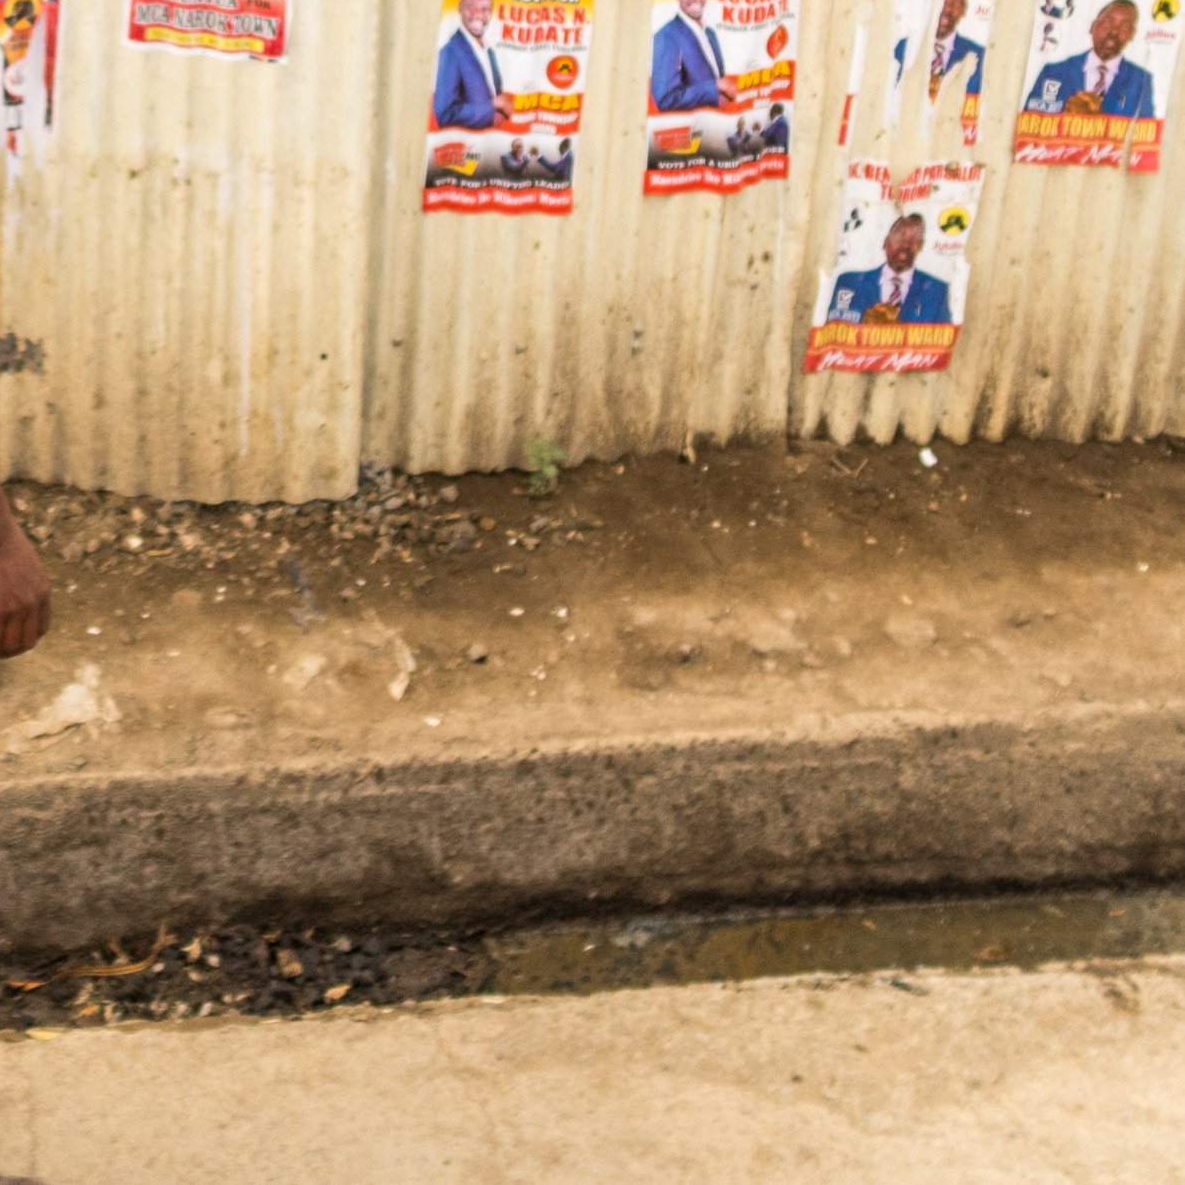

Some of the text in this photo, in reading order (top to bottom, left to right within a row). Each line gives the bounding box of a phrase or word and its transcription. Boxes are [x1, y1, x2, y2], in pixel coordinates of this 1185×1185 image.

[497, 3, 566, 26] LUCAS
[501, 23, 582, 46] KUDATE
[513, 94, 580, 113] MCA
[658, 158, 686, 170] VOTE
[434, 177, 532, 190] VOTE FOR UNIFYING
